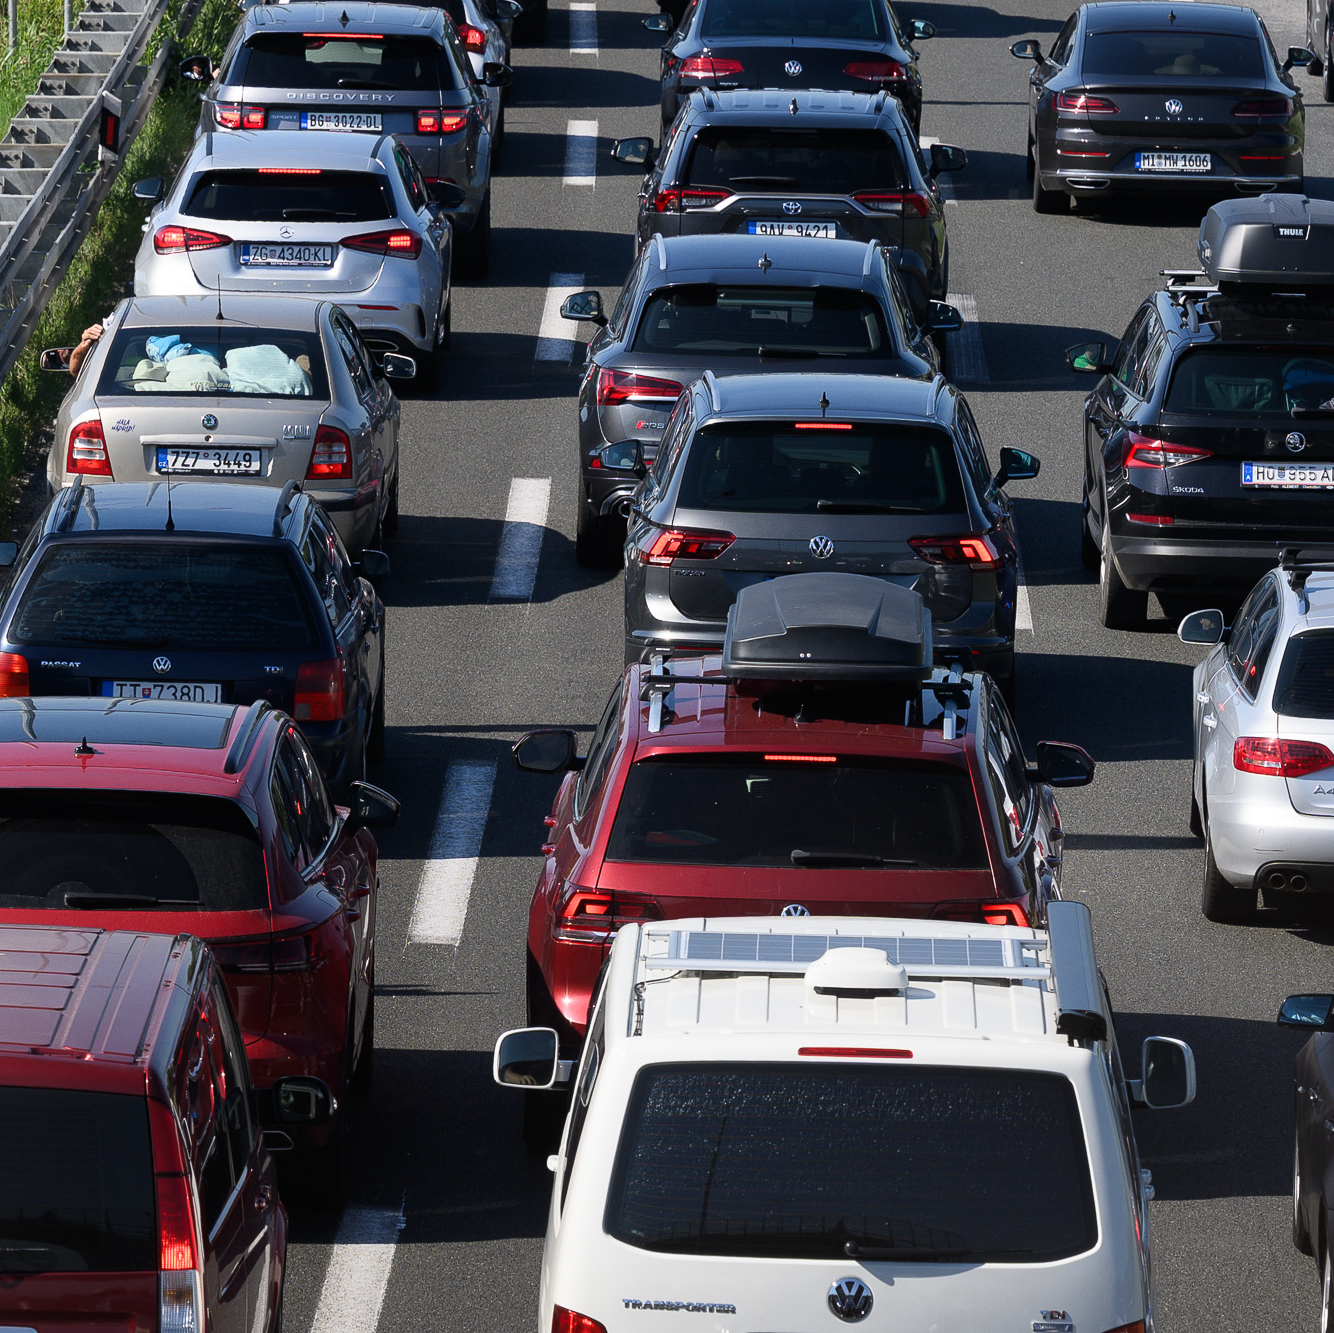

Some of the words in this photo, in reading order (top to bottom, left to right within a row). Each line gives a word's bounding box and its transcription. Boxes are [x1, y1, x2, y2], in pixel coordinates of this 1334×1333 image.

[286, 92, 396, 102] DISCOVERY
[310, 114, 324, 127] BG
[1142, 154, 1155, 166] MI
[1164, 154, 1178, 166] MW
[1181, 154, 1209, 167] 1606
[796, 225, 829, 238] 9421
[1279, 228, 1304, 236] THULE
[252, 247, 267, 260] ZG
[212, 452, 253, 468] 3449
[41, 661, 82, 669] PASSAT
[622, 1298, 736, 1314] TRANSPORTER
[1040, 1310, 1066, 1321] TDI
